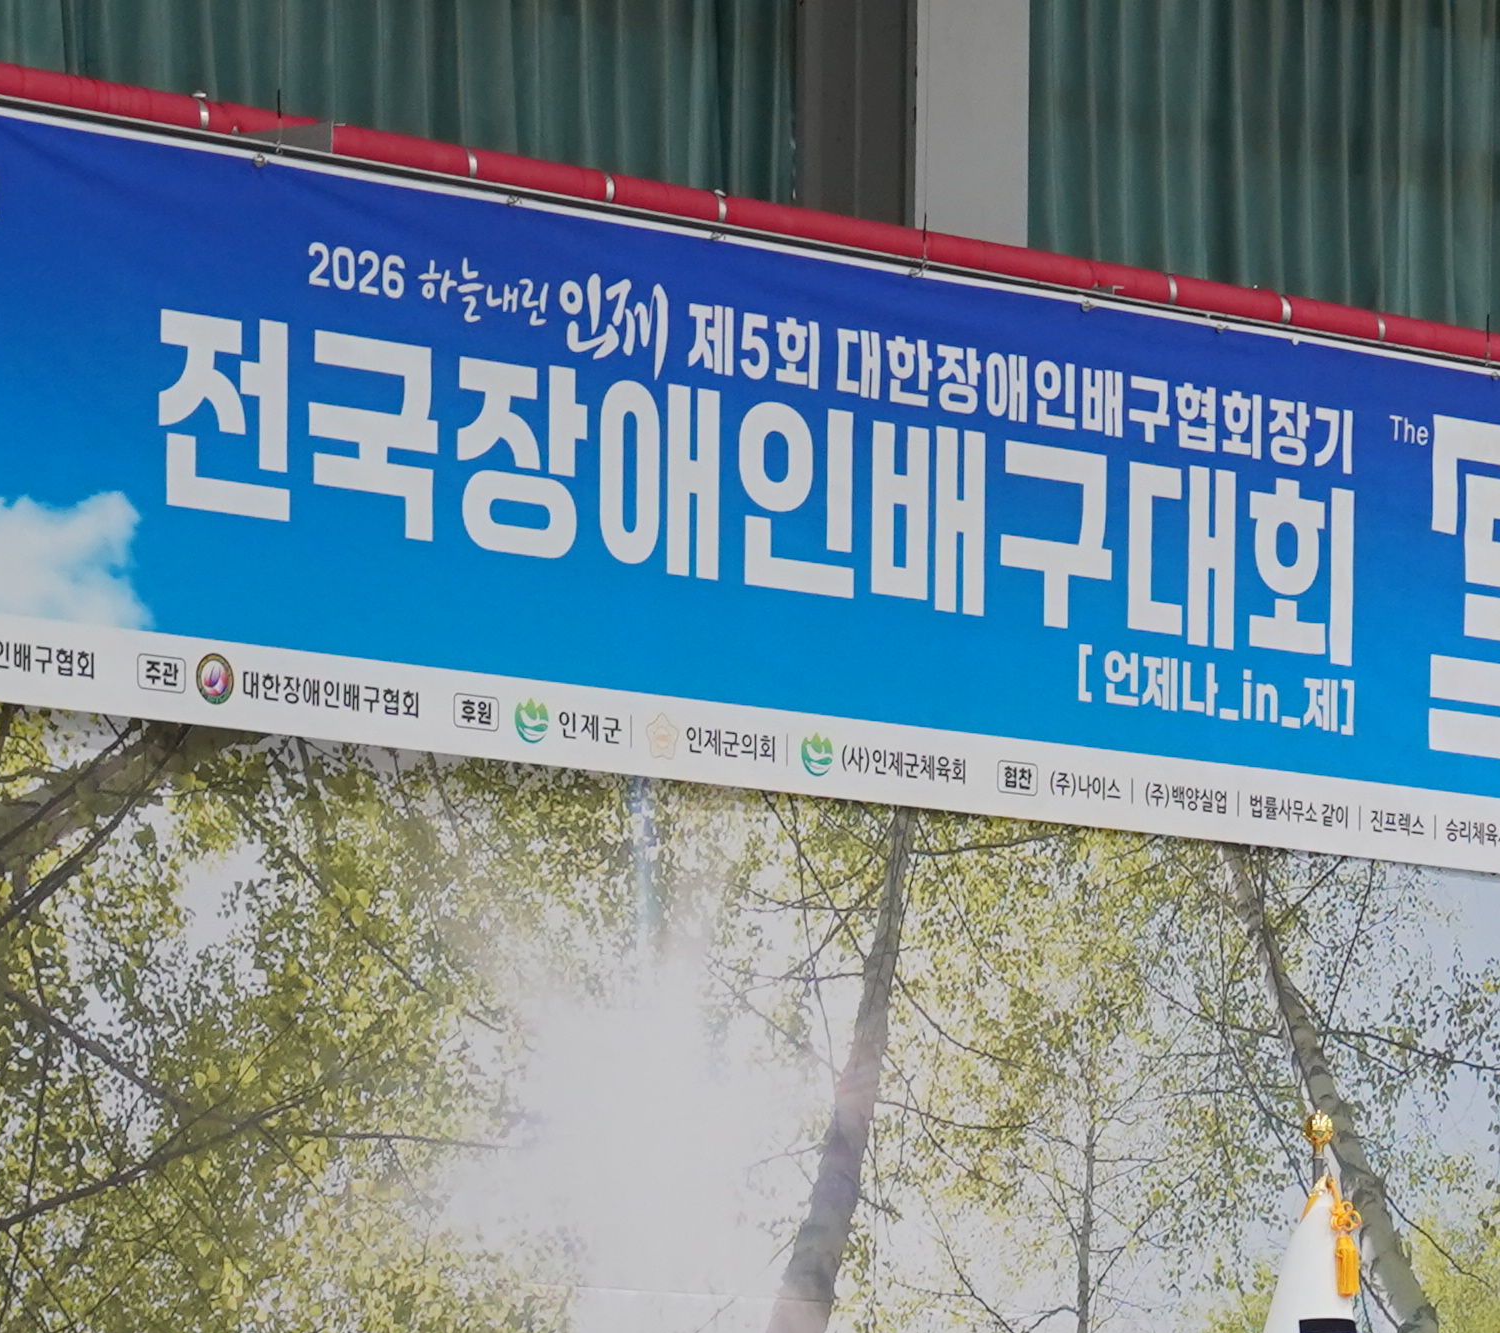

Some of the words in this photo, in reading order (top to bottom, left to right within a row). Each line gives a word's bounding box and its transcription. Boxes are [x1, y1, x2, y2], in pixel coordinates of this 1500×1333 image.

[307, 241, 405, 299] 2026
[417, 257, 550, 323] 하늘내린
[687, 302, 821, 390] 제5회
[837, 328, 1354, 475] 대한장애인배구협회장기
[1389, 414, 1430, 447] The
[157, 307, 1356, 667] 전국장애인배구대회
[144, 660, 179, 689] 주관
[241, 670, 421, 721] 대한장애인배구협회
[460, 700, 493, 726] 후원
[558, 711, 623, 746] 인제군
[685, 726, 777, 764] 인제군의회
[841, 742, 967, 786] (사)인제군체육회
[1003, 766, 1033, 792] 협찬
[1049, 769, 1122, 801] (주)나이스
[1144, 780, 1228, 815] (주)백양실업
[1249, 794, 1318, 823] 법률사무소
[1320, 804, 1349, 830] 같이
[1369, 809, 1425, 837] 진프렉스
